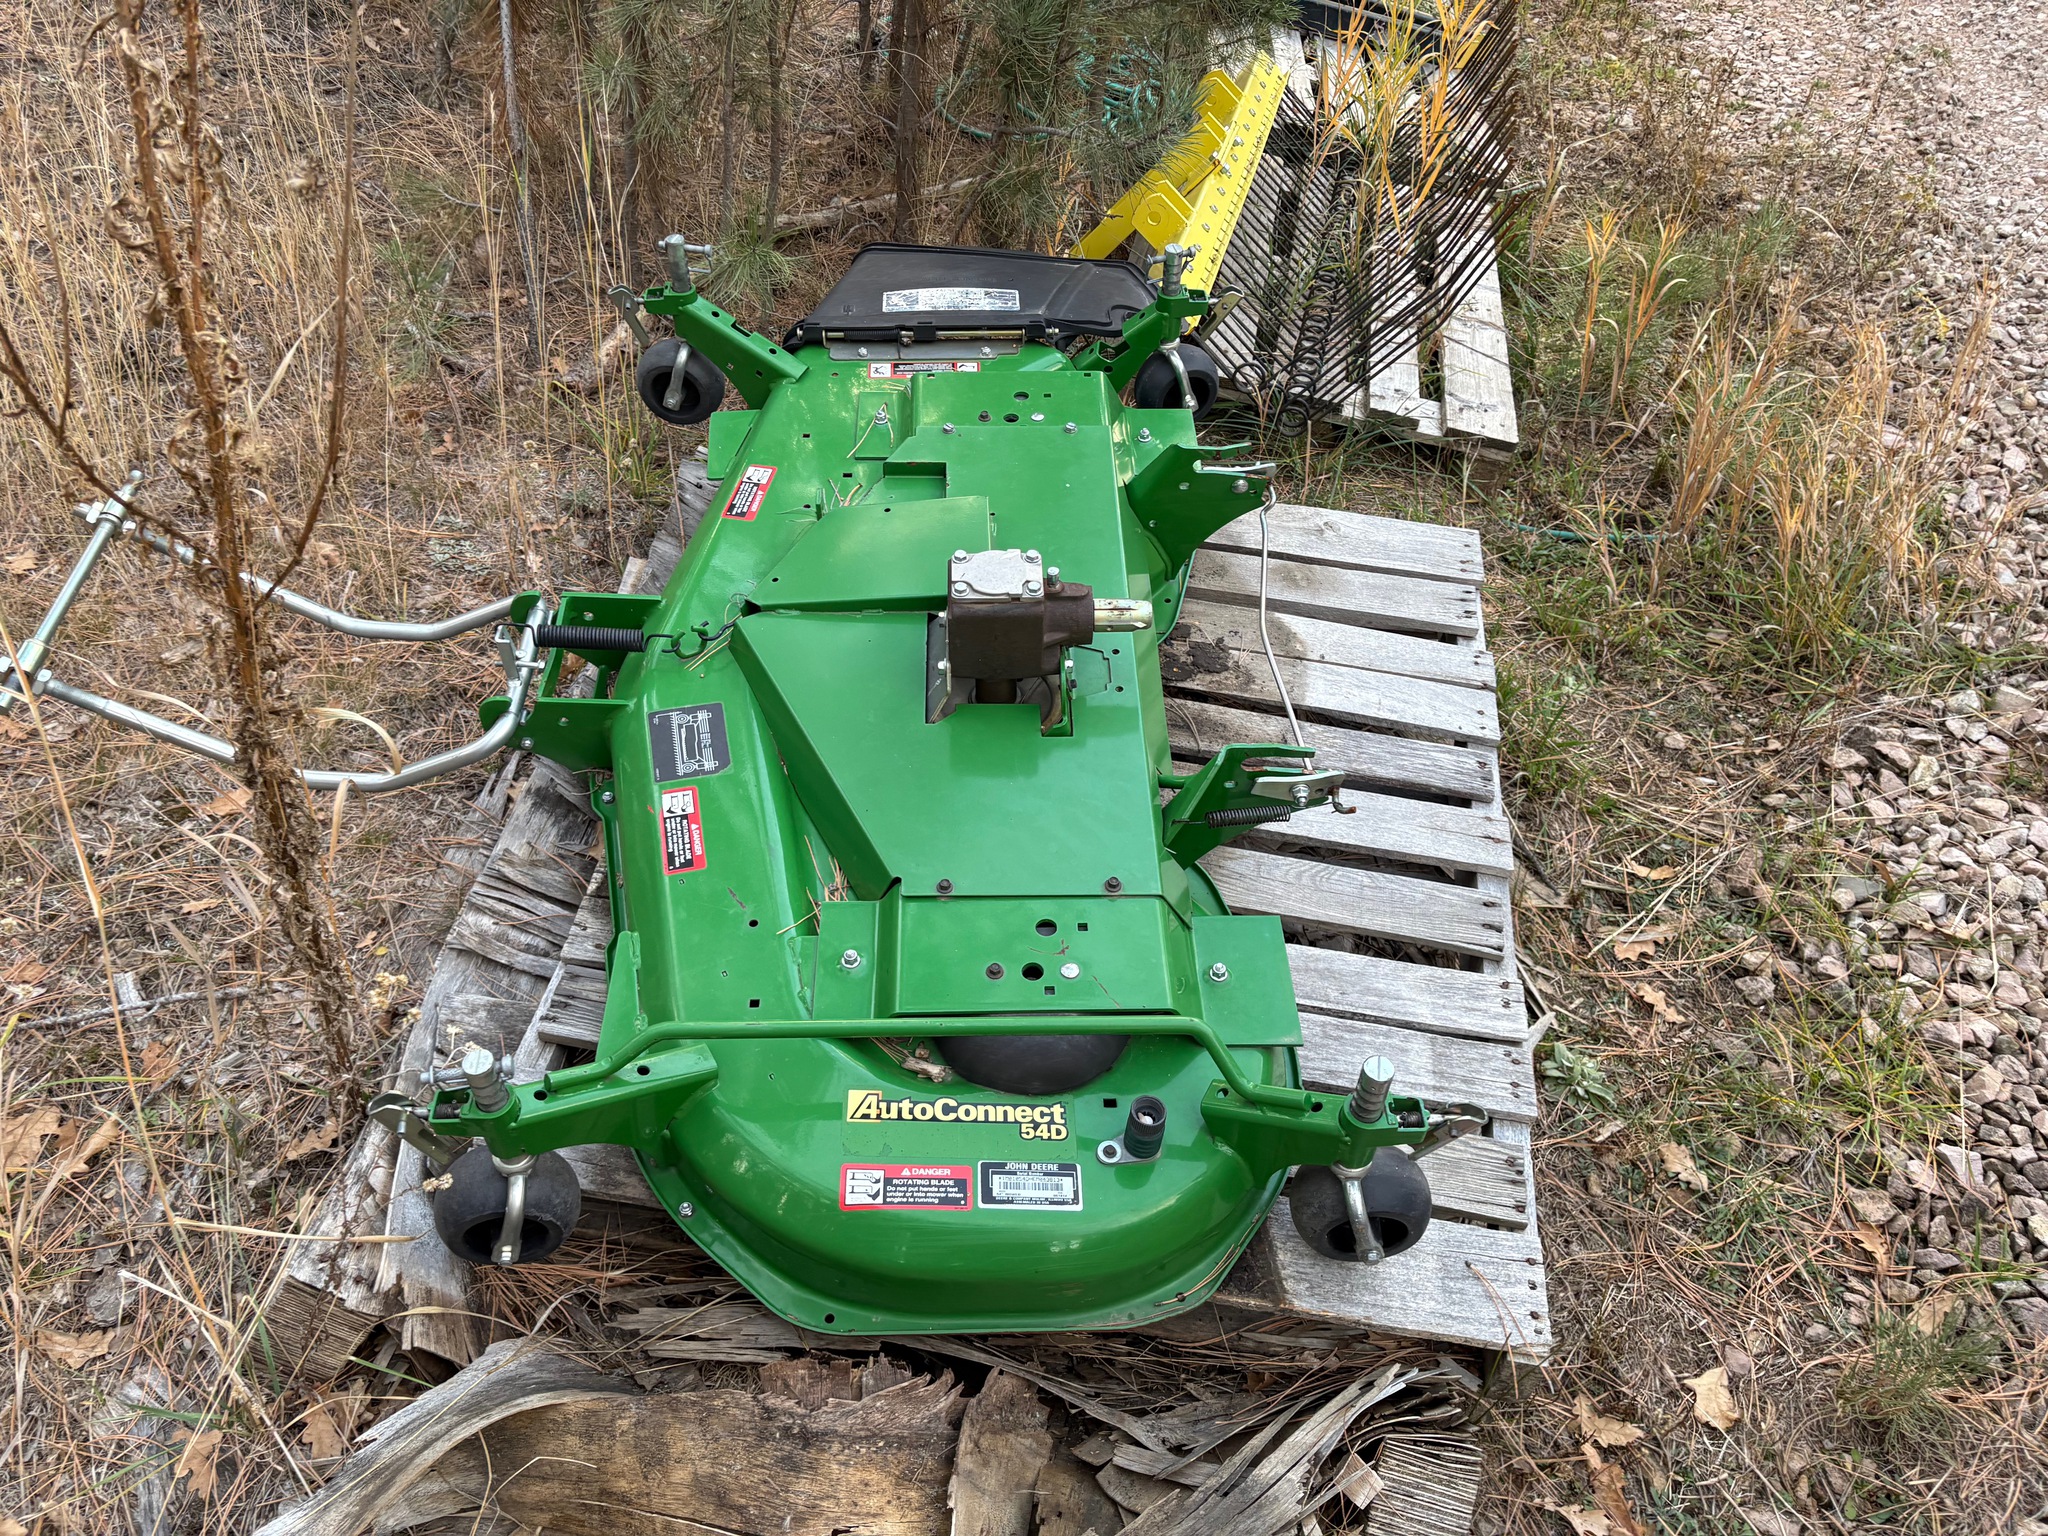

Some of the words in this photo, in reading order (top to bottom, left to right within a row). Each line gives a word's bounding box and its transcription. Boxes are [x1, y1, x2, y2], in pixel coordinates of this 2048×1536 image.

[693, 829, 702, 856] DANGER
[850, 1093, 1066, 1124] AutoConnect
[1020, 1123, 1068, 1140] 54D
[912, 1168, 951, 1176] DANGER
[1004, 1162, 1028, 1170] JOHN
[1031, 1163, 1059, 1171] DEERE
